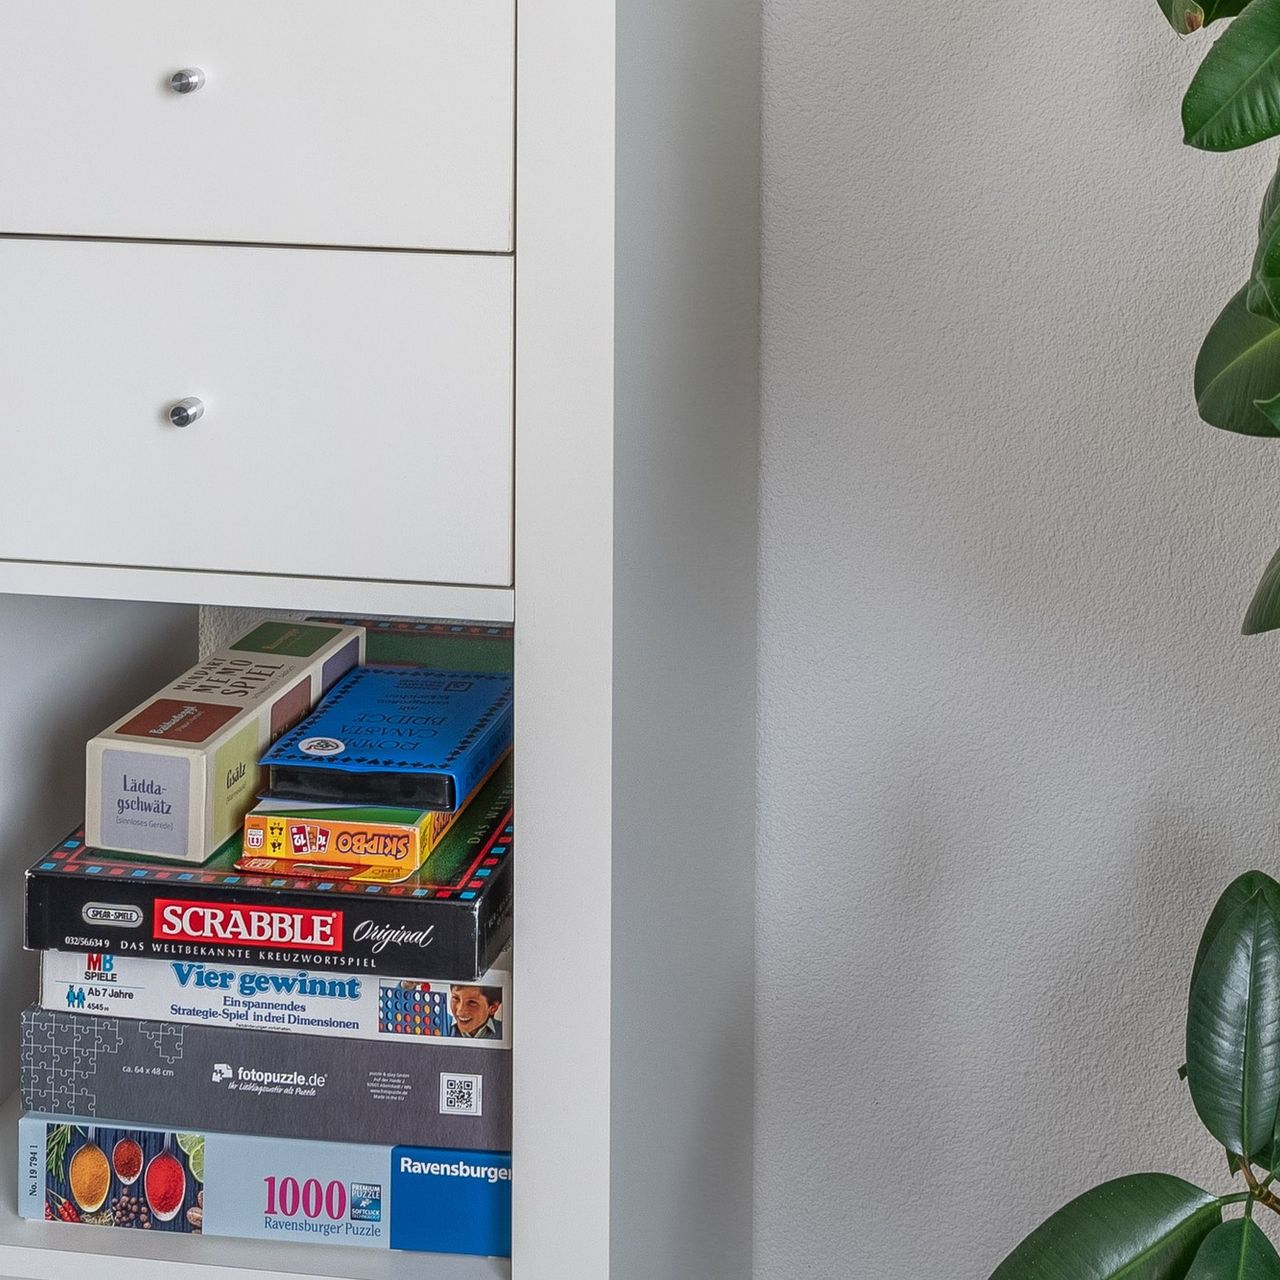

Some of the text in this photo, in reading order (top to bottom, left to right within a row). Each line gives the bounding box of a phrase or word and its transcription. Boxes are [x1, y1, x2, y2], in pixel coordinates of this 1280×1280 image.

[173, 657, 226, 691] MUNDART
[192, 659, 254, 694] MEMO
[220, 663, 286, 698] SPIEL
[353, 712, 447, 727] BRIDGE
[339, 725, 439, 738] CANASTA
[123, 774, 167, 796] Lädda-
[117, 796, 172, 815] gschwätz
[293, 834, 307, 846] 12
[91, 909, 134, 921] SPEAR-SPIELE
[161, 905, 335, 946] SCRABBLE
[352, 919, 435, 954] Original
[87, 951, 114, 973] MB
[120, 940, 377, 968] DAS WELTBEKANNTE KREUZWORTSPIEL
[84, 971, 118, 983] SPIELE
[171, 962, 361, 1000] Vier gewinnt
[87, 987, 135, 1000] Ab 7 Jahre
[223, 996, 307, 1013] Ein spannendes
[170, 1005, 360, 1030] Strategie-Spiel in drei Dimensionen
[122, 1065, 133, 1073] ca.
[134, 1066, 144, 1074] 64
[151, 1067, 161, 1076] 48
[162, 1069, 174, 1077] cm
[238, 1067, 326, 1087] fotopuzzle.de
[29, 1152, 38, 1168] 794
[29, 1169, 38, 1179] 19
[28, 1182, 38, 1197] No.
[263, 1176, 347, 1221] 1000
[351, 1190, 381, 1200] PUZZLE
[264, 1216, 382, 1238] Ravensburger Puzzle
